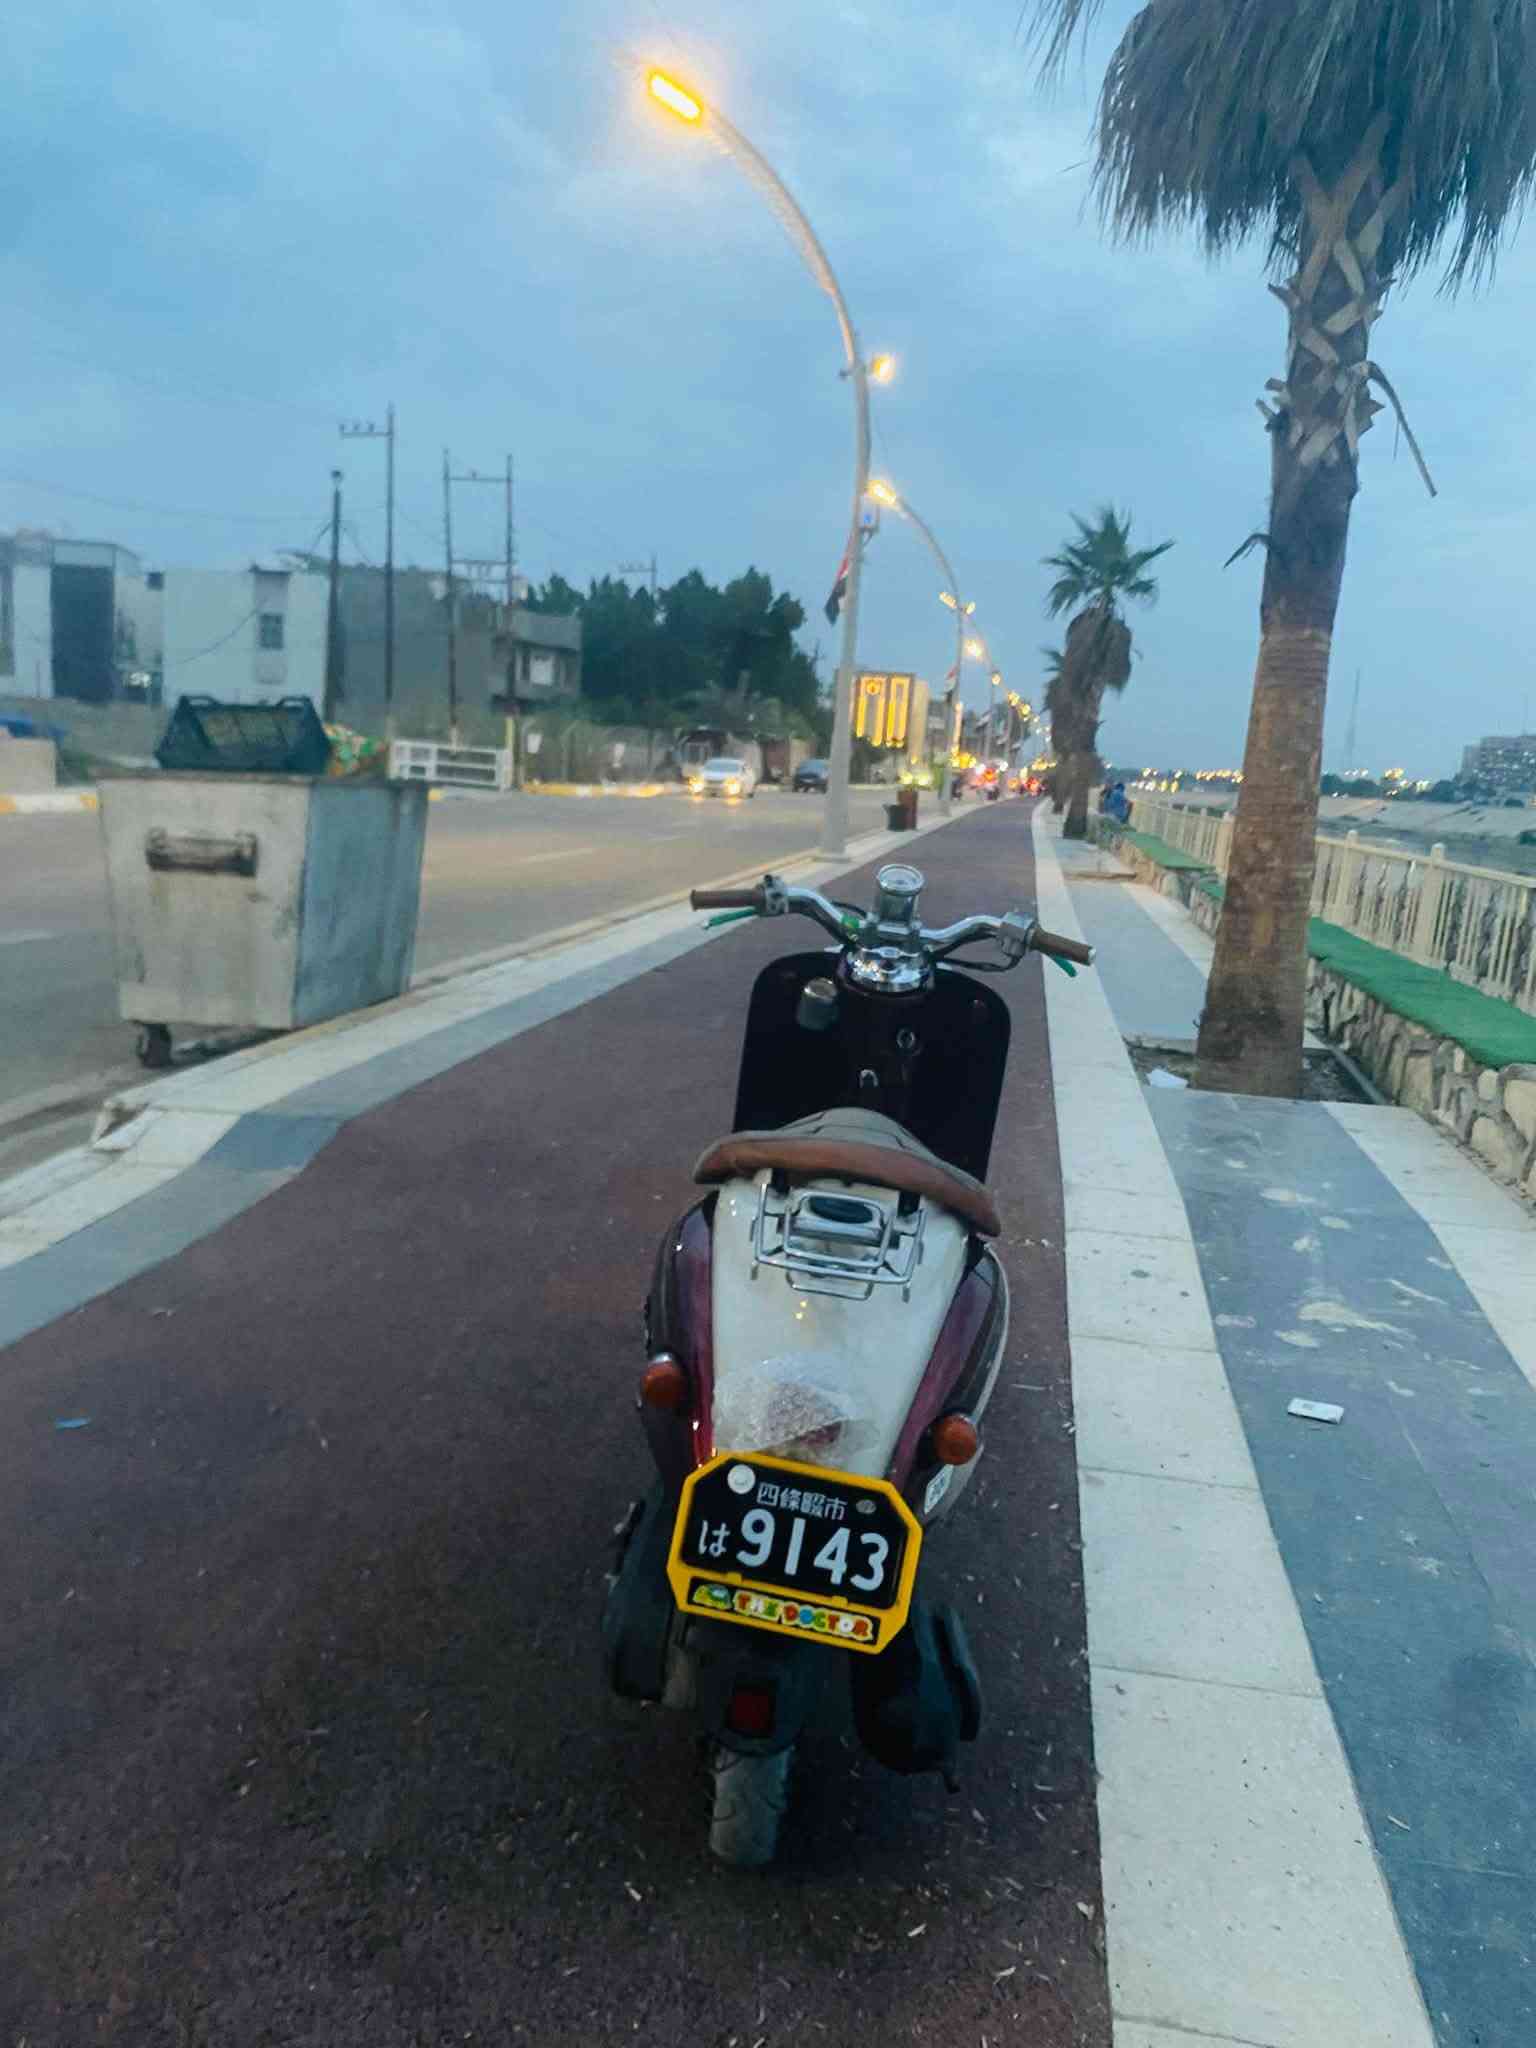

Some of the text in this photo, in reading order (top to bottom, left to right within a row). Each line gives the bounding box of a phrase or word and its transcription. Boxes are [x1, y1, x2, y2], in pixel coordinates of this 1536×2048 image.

[698, 1508, 889, 1591] は 9143
[783, 1602, 872, 1638] DOCTOR
